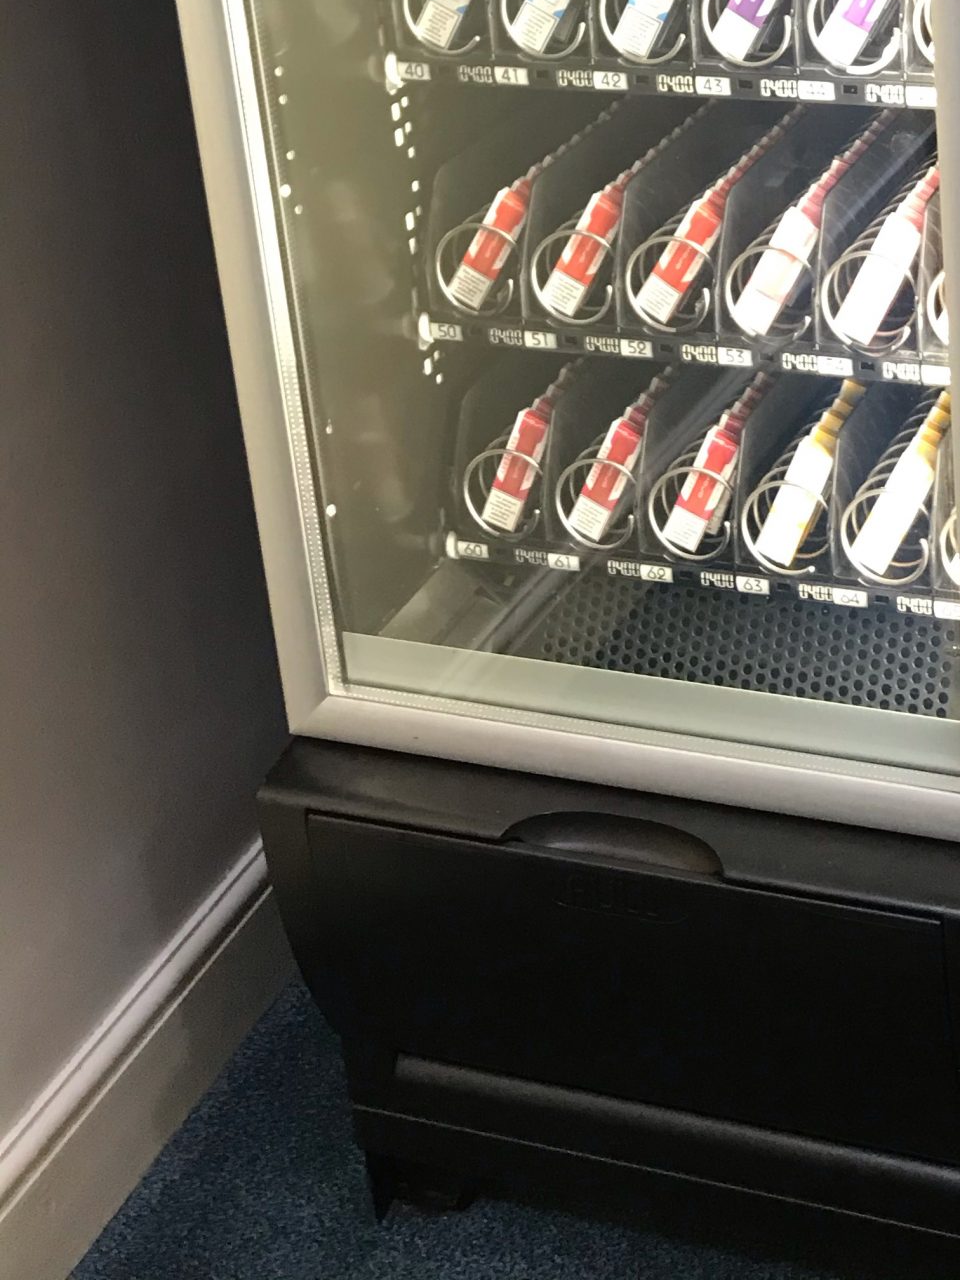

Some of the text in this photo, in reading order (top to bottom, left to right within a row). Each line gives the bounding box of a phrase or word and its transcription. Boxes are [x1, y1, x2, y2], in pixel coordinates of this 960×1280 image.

[405, 64, 424, 79] 40
[501, 69, 519, 83] 41
[601, 73, 622, 88] 42
[703, 78, 723, 93] 43
[438, 324, 457, 339] 50
[531, 332, 549, 346] 51
[628, 341, 647, 355] 52
[726, 349, 745, 364] 53
[464, 543, 483, 557] 60
[554, 555, 572, 569] 61
[647, 566, 666, 581] 62
[743, 578, 763, 593] 63
